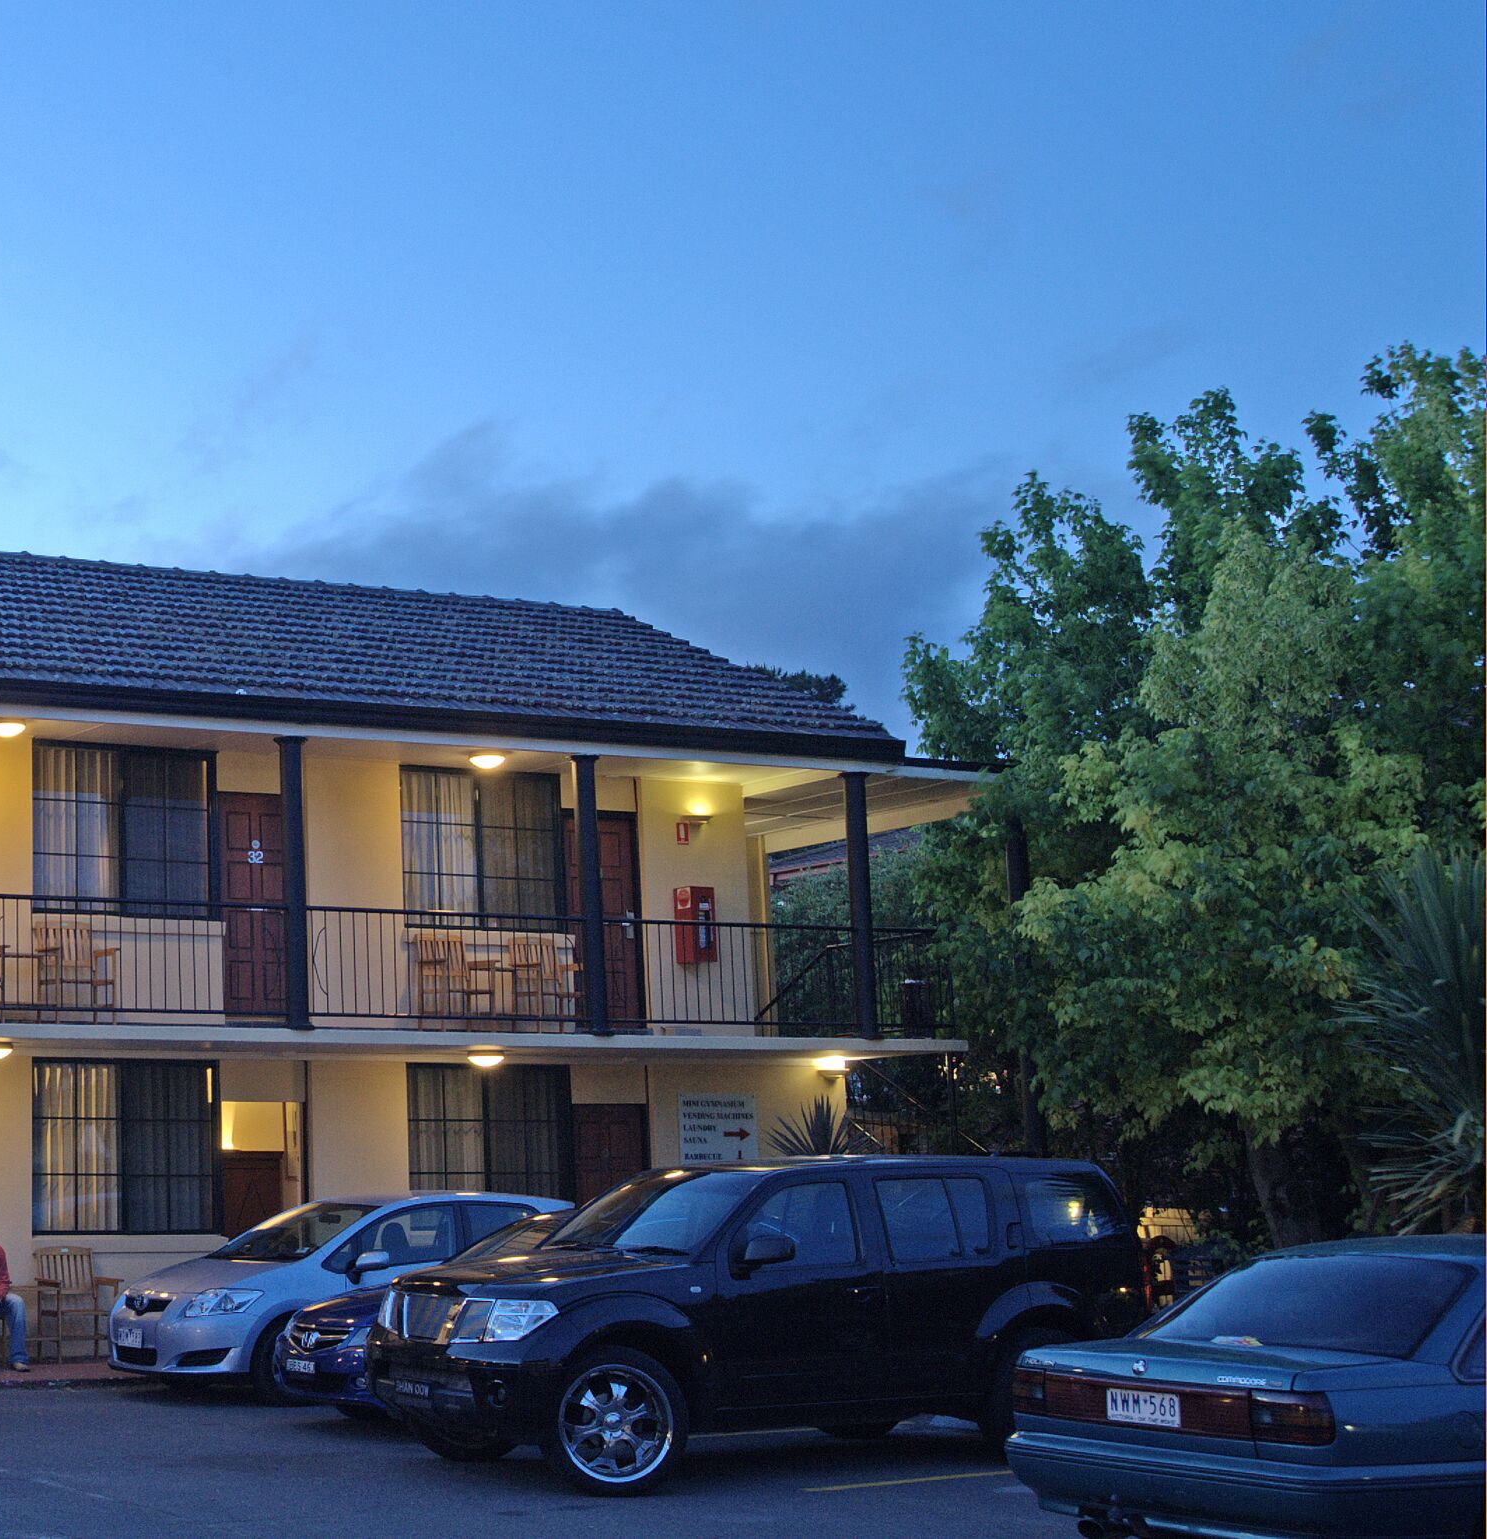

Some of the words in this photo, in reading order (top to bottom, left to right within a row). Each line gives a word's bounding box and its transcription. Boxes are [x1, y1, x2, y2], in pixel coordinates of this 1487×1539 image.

[247, 850, 264, 864] 32
[700, 1101, 745, 1109] GYMNASIUM
[683, 1112, 715, 1120] VENDING
[717, 1112, 754, 1120] MACHINES
[1149, 1395, 1176, 1418] 568
